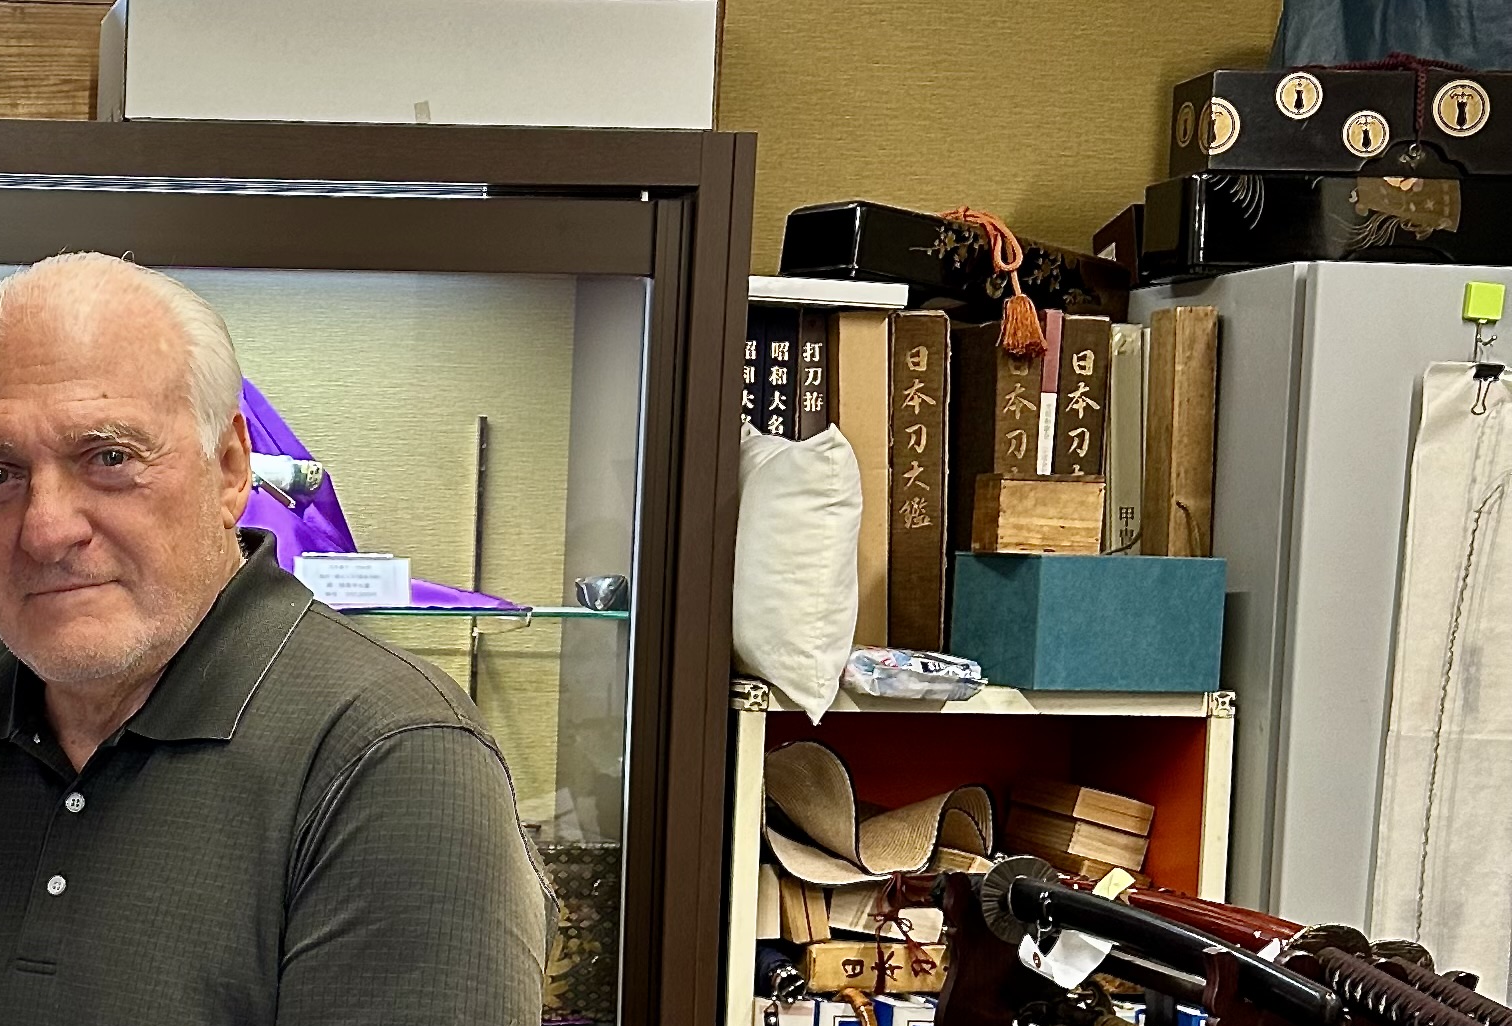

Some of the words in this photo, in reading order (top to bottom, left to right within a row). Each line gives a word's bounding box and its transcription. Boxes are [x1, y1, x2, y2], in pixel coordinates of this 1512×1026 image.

[769, 341, 789, 434] 昭和大名
[803, 342, 824, 412] 打刀拵
[1003, 354, 1037, 475] 日本刀
[899, 345, 937, 529] 日本刀大鑑
[841, 951, 949, 983] 日本刀
